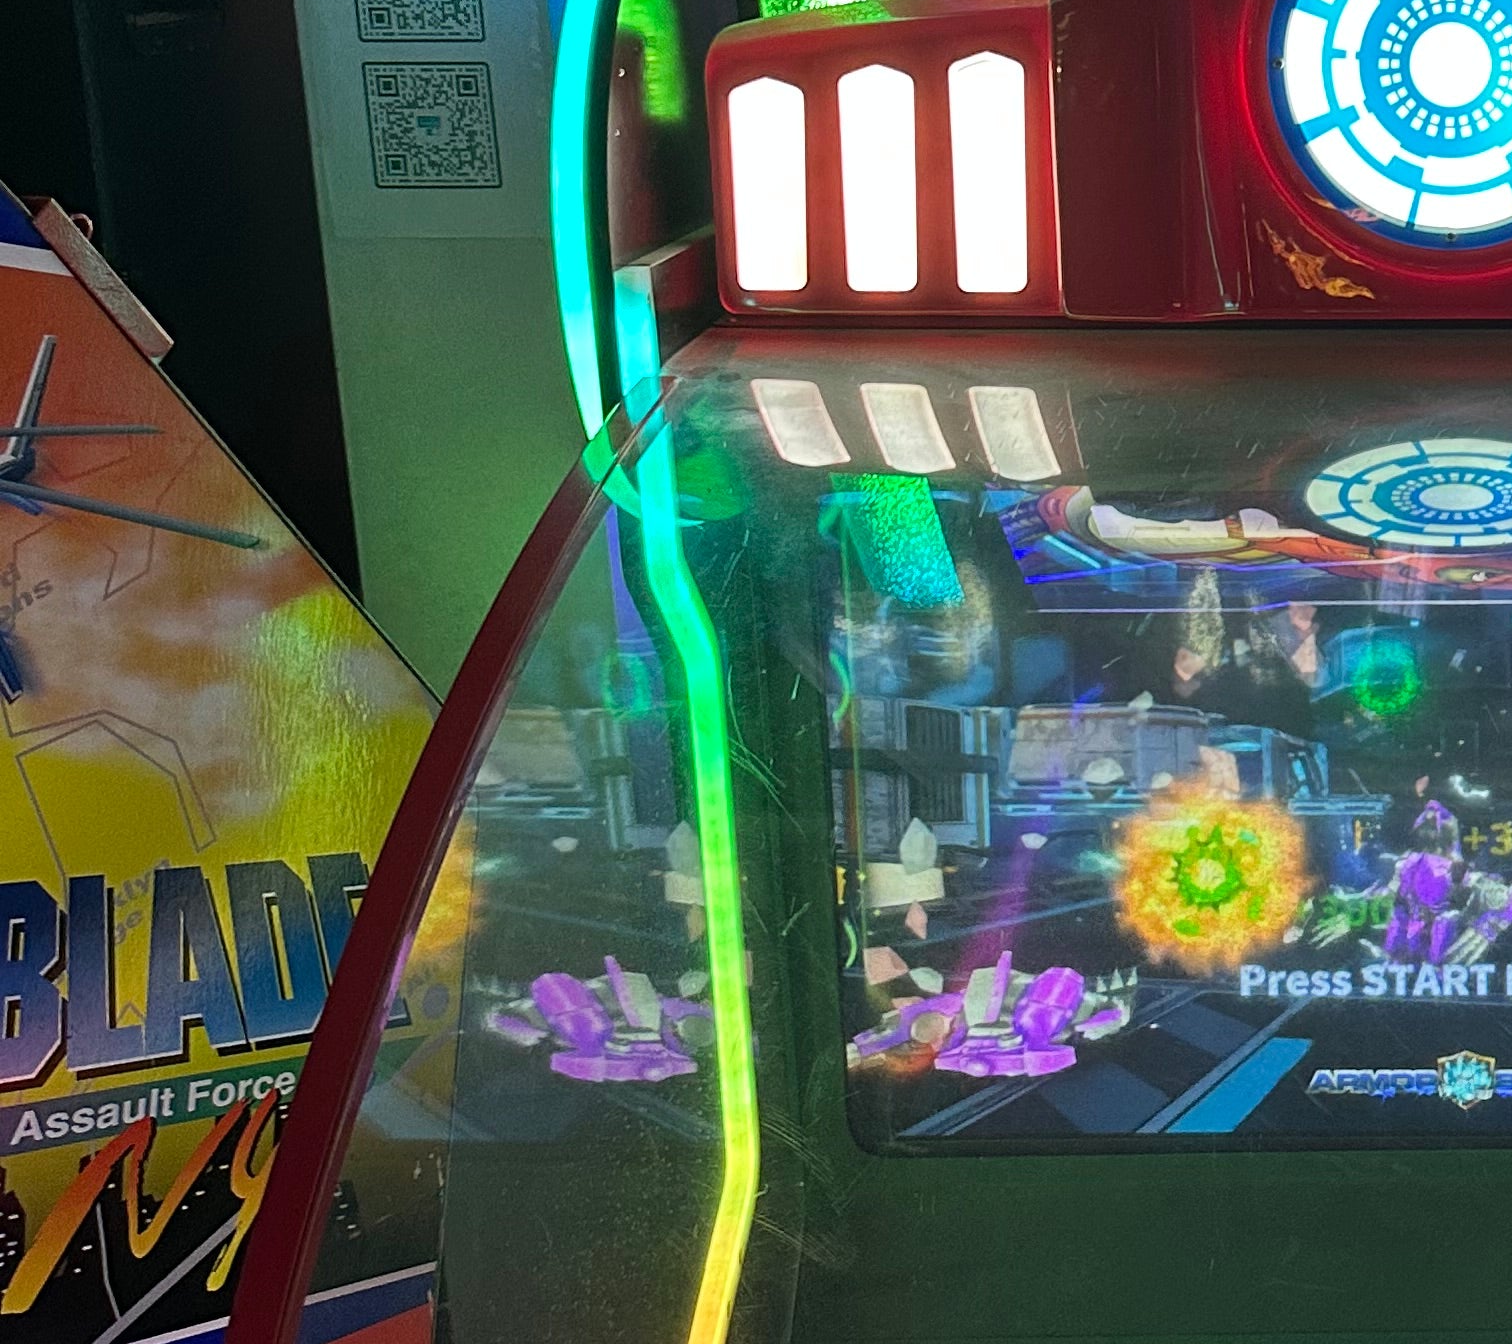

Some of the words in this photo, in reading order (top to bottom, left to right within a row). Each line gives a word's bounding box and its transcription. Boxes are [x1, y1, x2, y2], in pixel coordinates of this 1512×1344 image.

[1240, 964, 1353, 997] Press
[1361, 964, 1495, 997] START
[10, 1086, 175, 1146] Assault
[187, 1071, 296, 1113] Force
